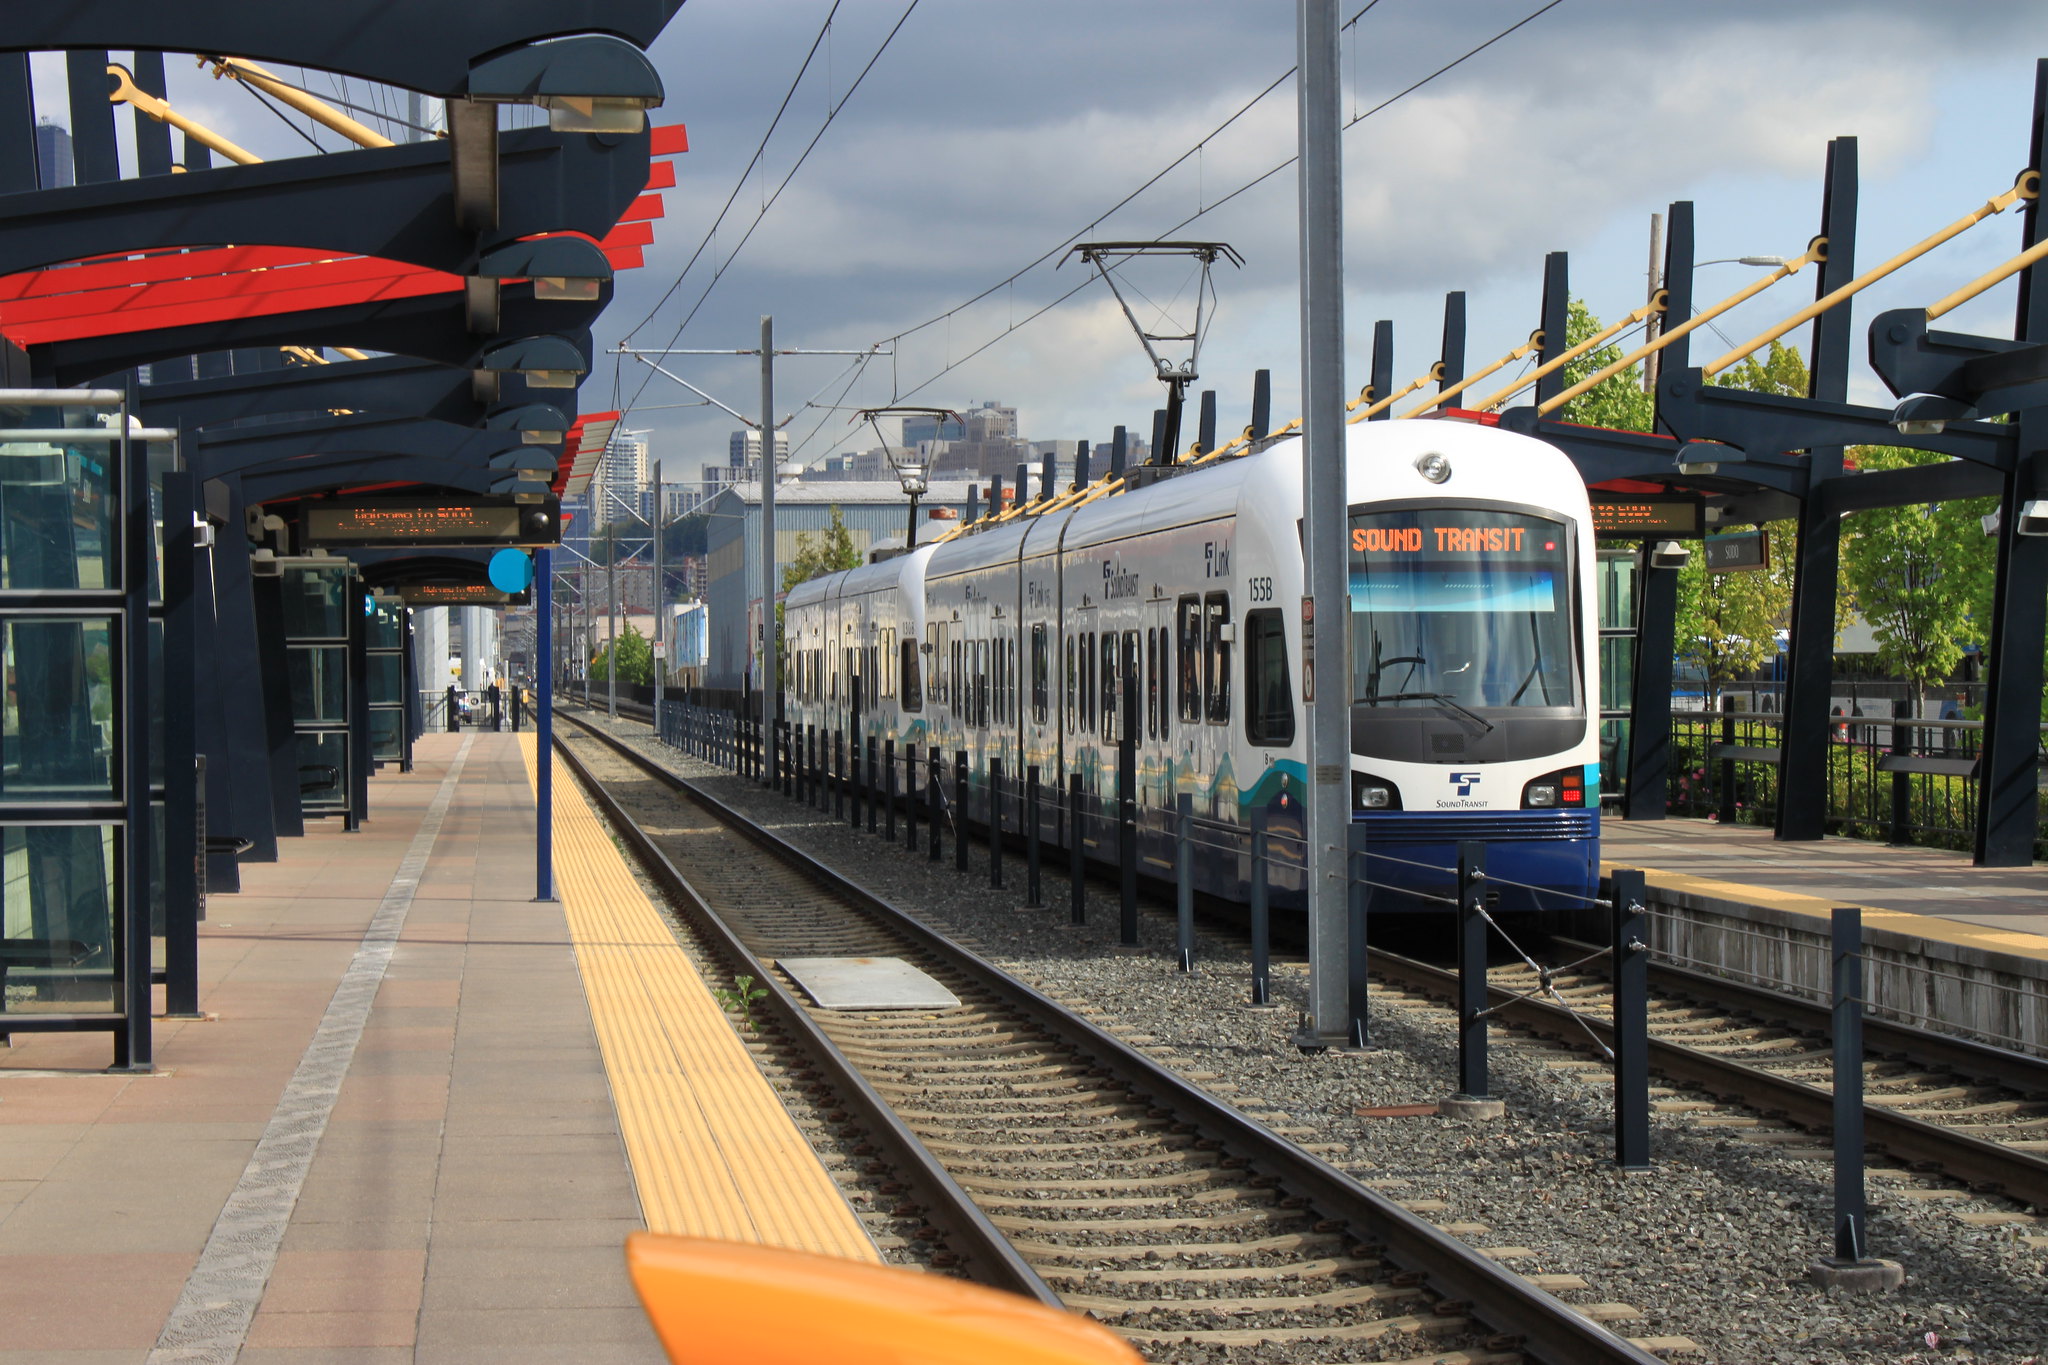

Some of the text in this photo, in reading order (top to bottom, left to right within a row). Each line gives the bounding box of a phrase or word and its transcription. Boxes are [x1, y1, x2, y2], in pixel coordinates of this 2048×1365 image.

[1352, 528, 1525, 552] SOUND TRANSIT
[1248, 577, 1273, 602] 155B
